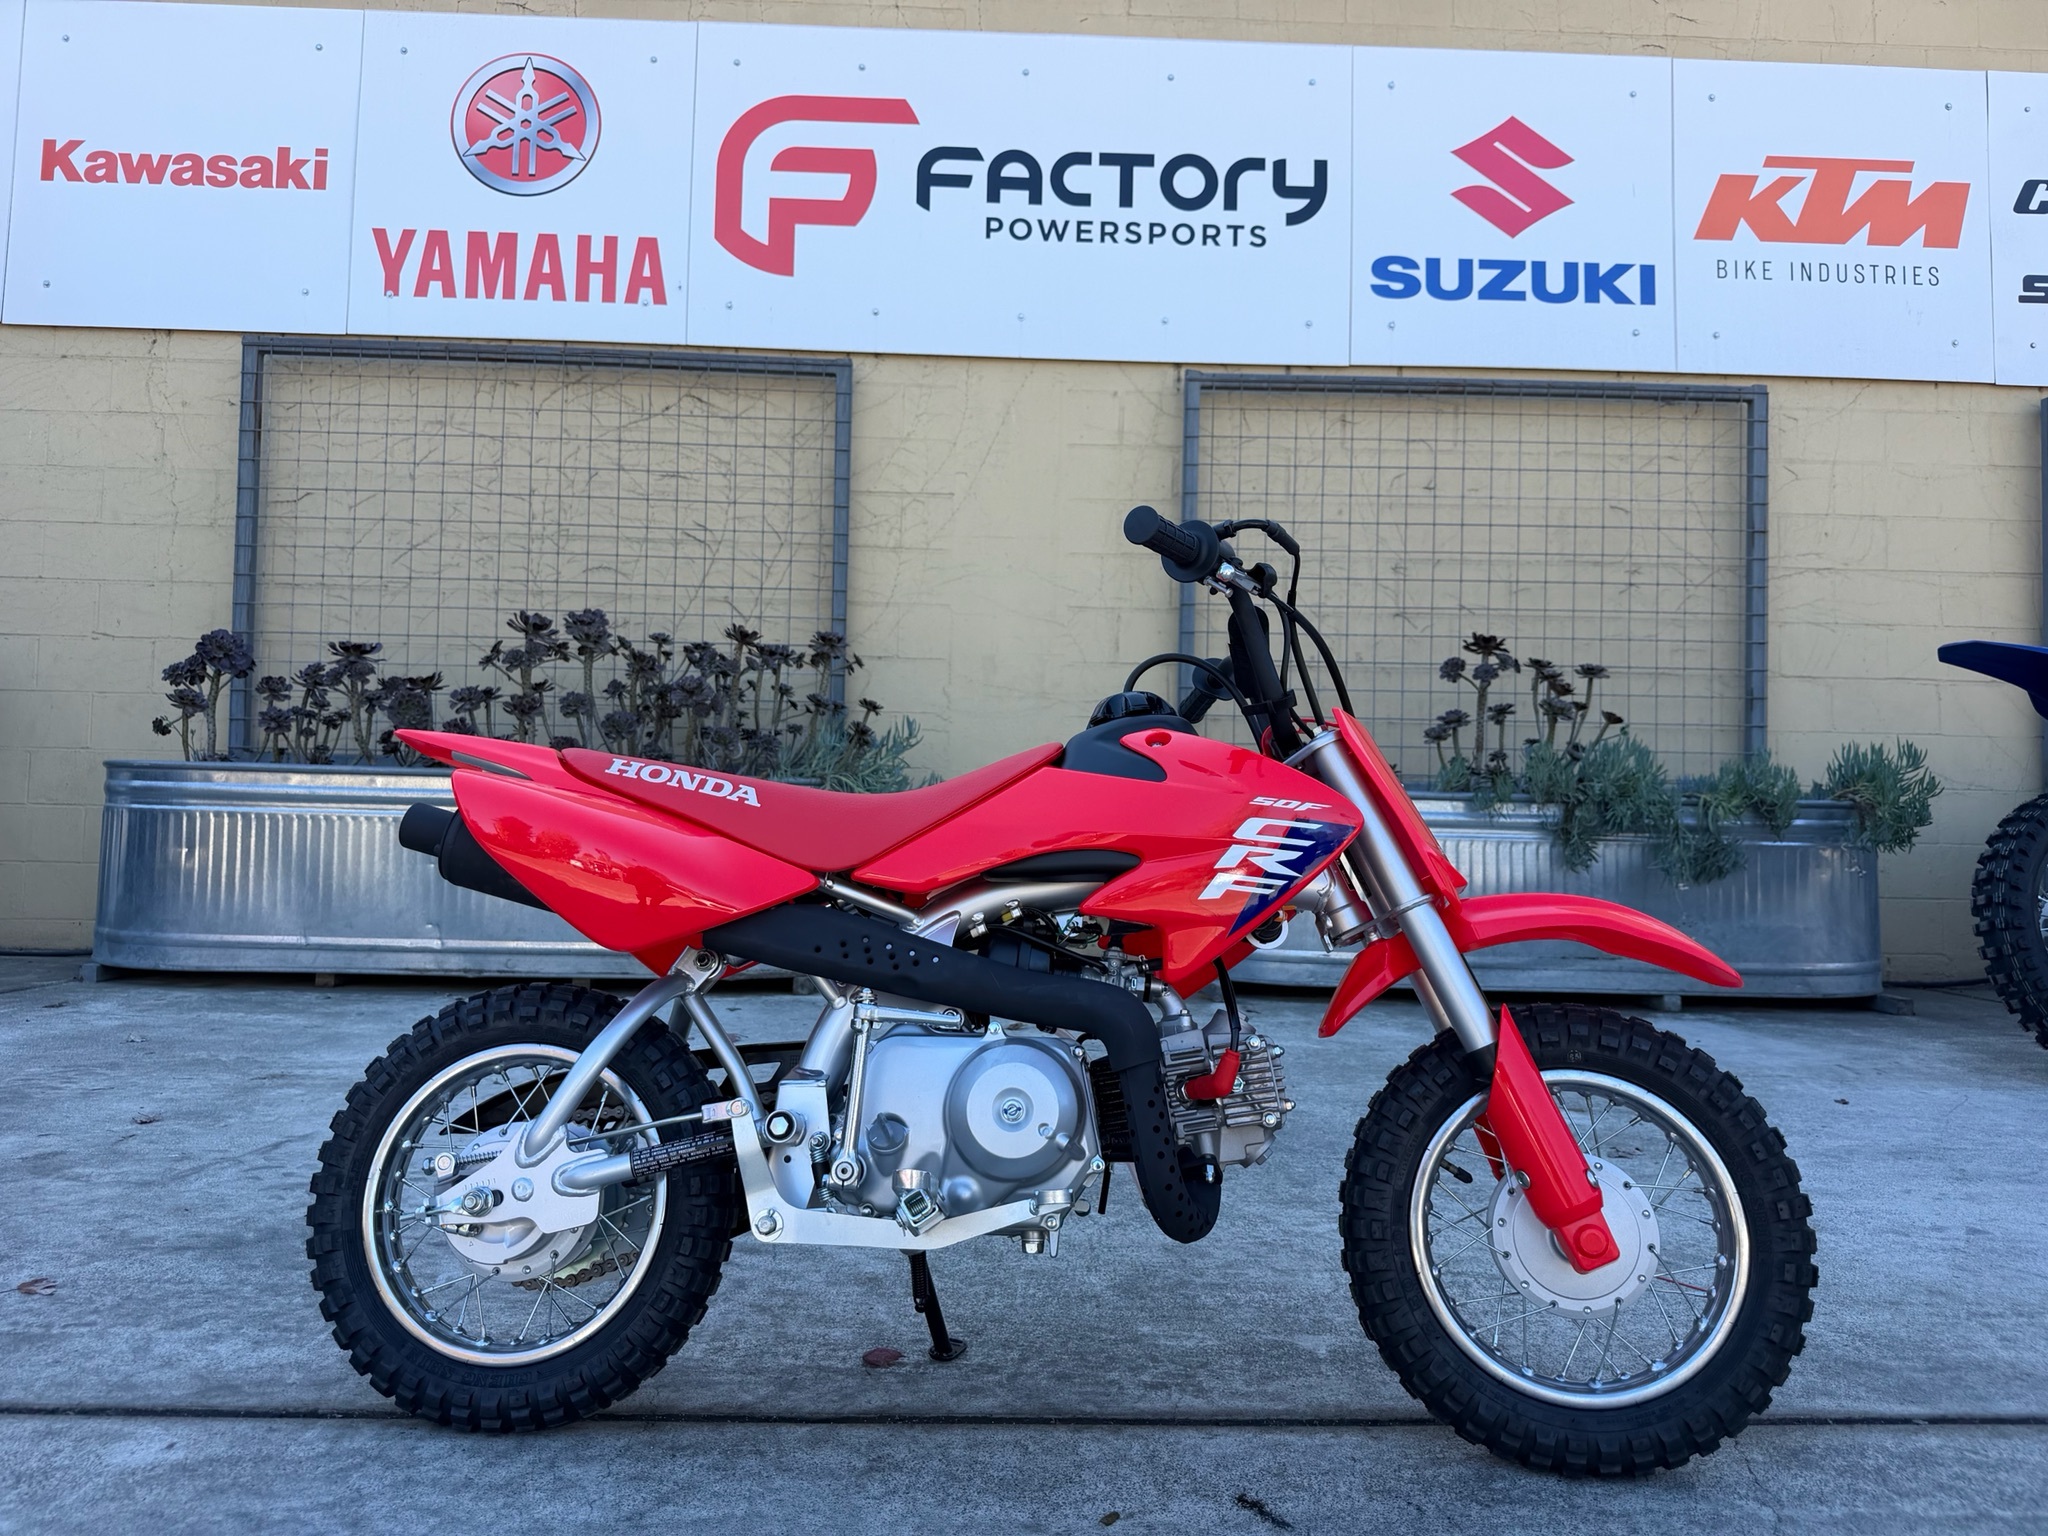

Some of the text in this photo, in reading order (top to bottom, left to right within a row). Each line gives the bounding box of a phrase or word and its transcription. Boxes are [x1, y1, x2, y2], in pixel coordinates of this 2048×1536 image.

[41, 139, 328, 190] Kawasaki
[916, 146, 1328, 226] FACTORY
[1690, 155, 1970, 248] KTM
[985, 216, 1268, 248] POWERSPORTS
[372, 227, 667, 306] YAMAHA
[1370, 255, 1657, 306] SUZUKI
[1716, 259, 1941, 288] BIKE INDUSTRIES
[604, 758, 762, 808] HONDA
[1249, 796, 1333, 812] 50F
[1198, 818, 1323, 900] CRF
